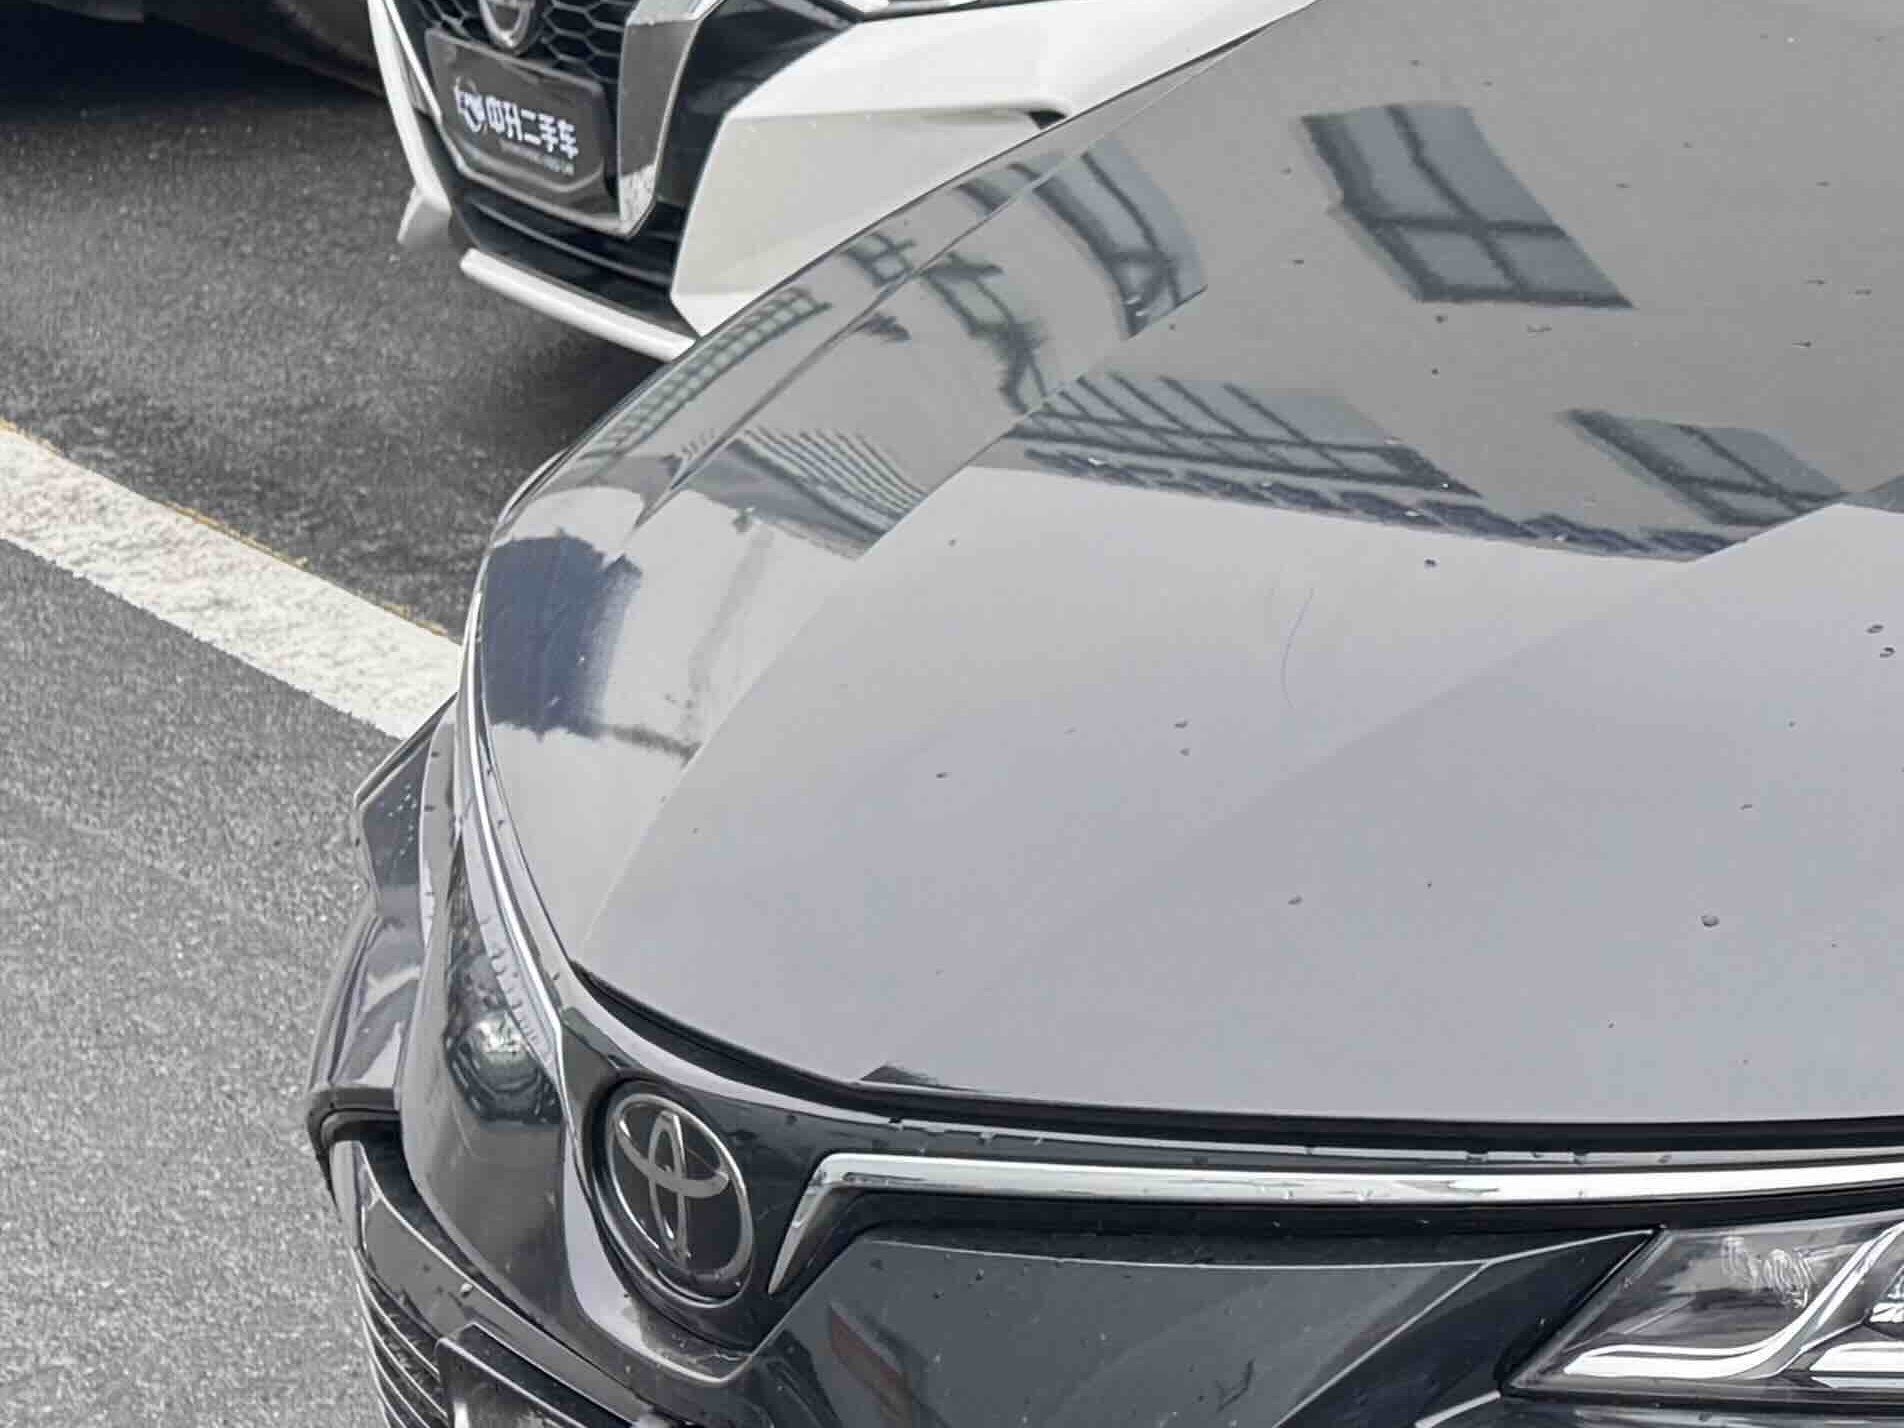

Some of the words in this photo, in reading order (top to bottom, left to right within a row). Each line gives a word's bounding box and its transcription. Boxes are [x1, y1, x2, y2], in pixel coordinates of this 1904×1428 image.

[485, 95, 579, 160] 中升二手车
